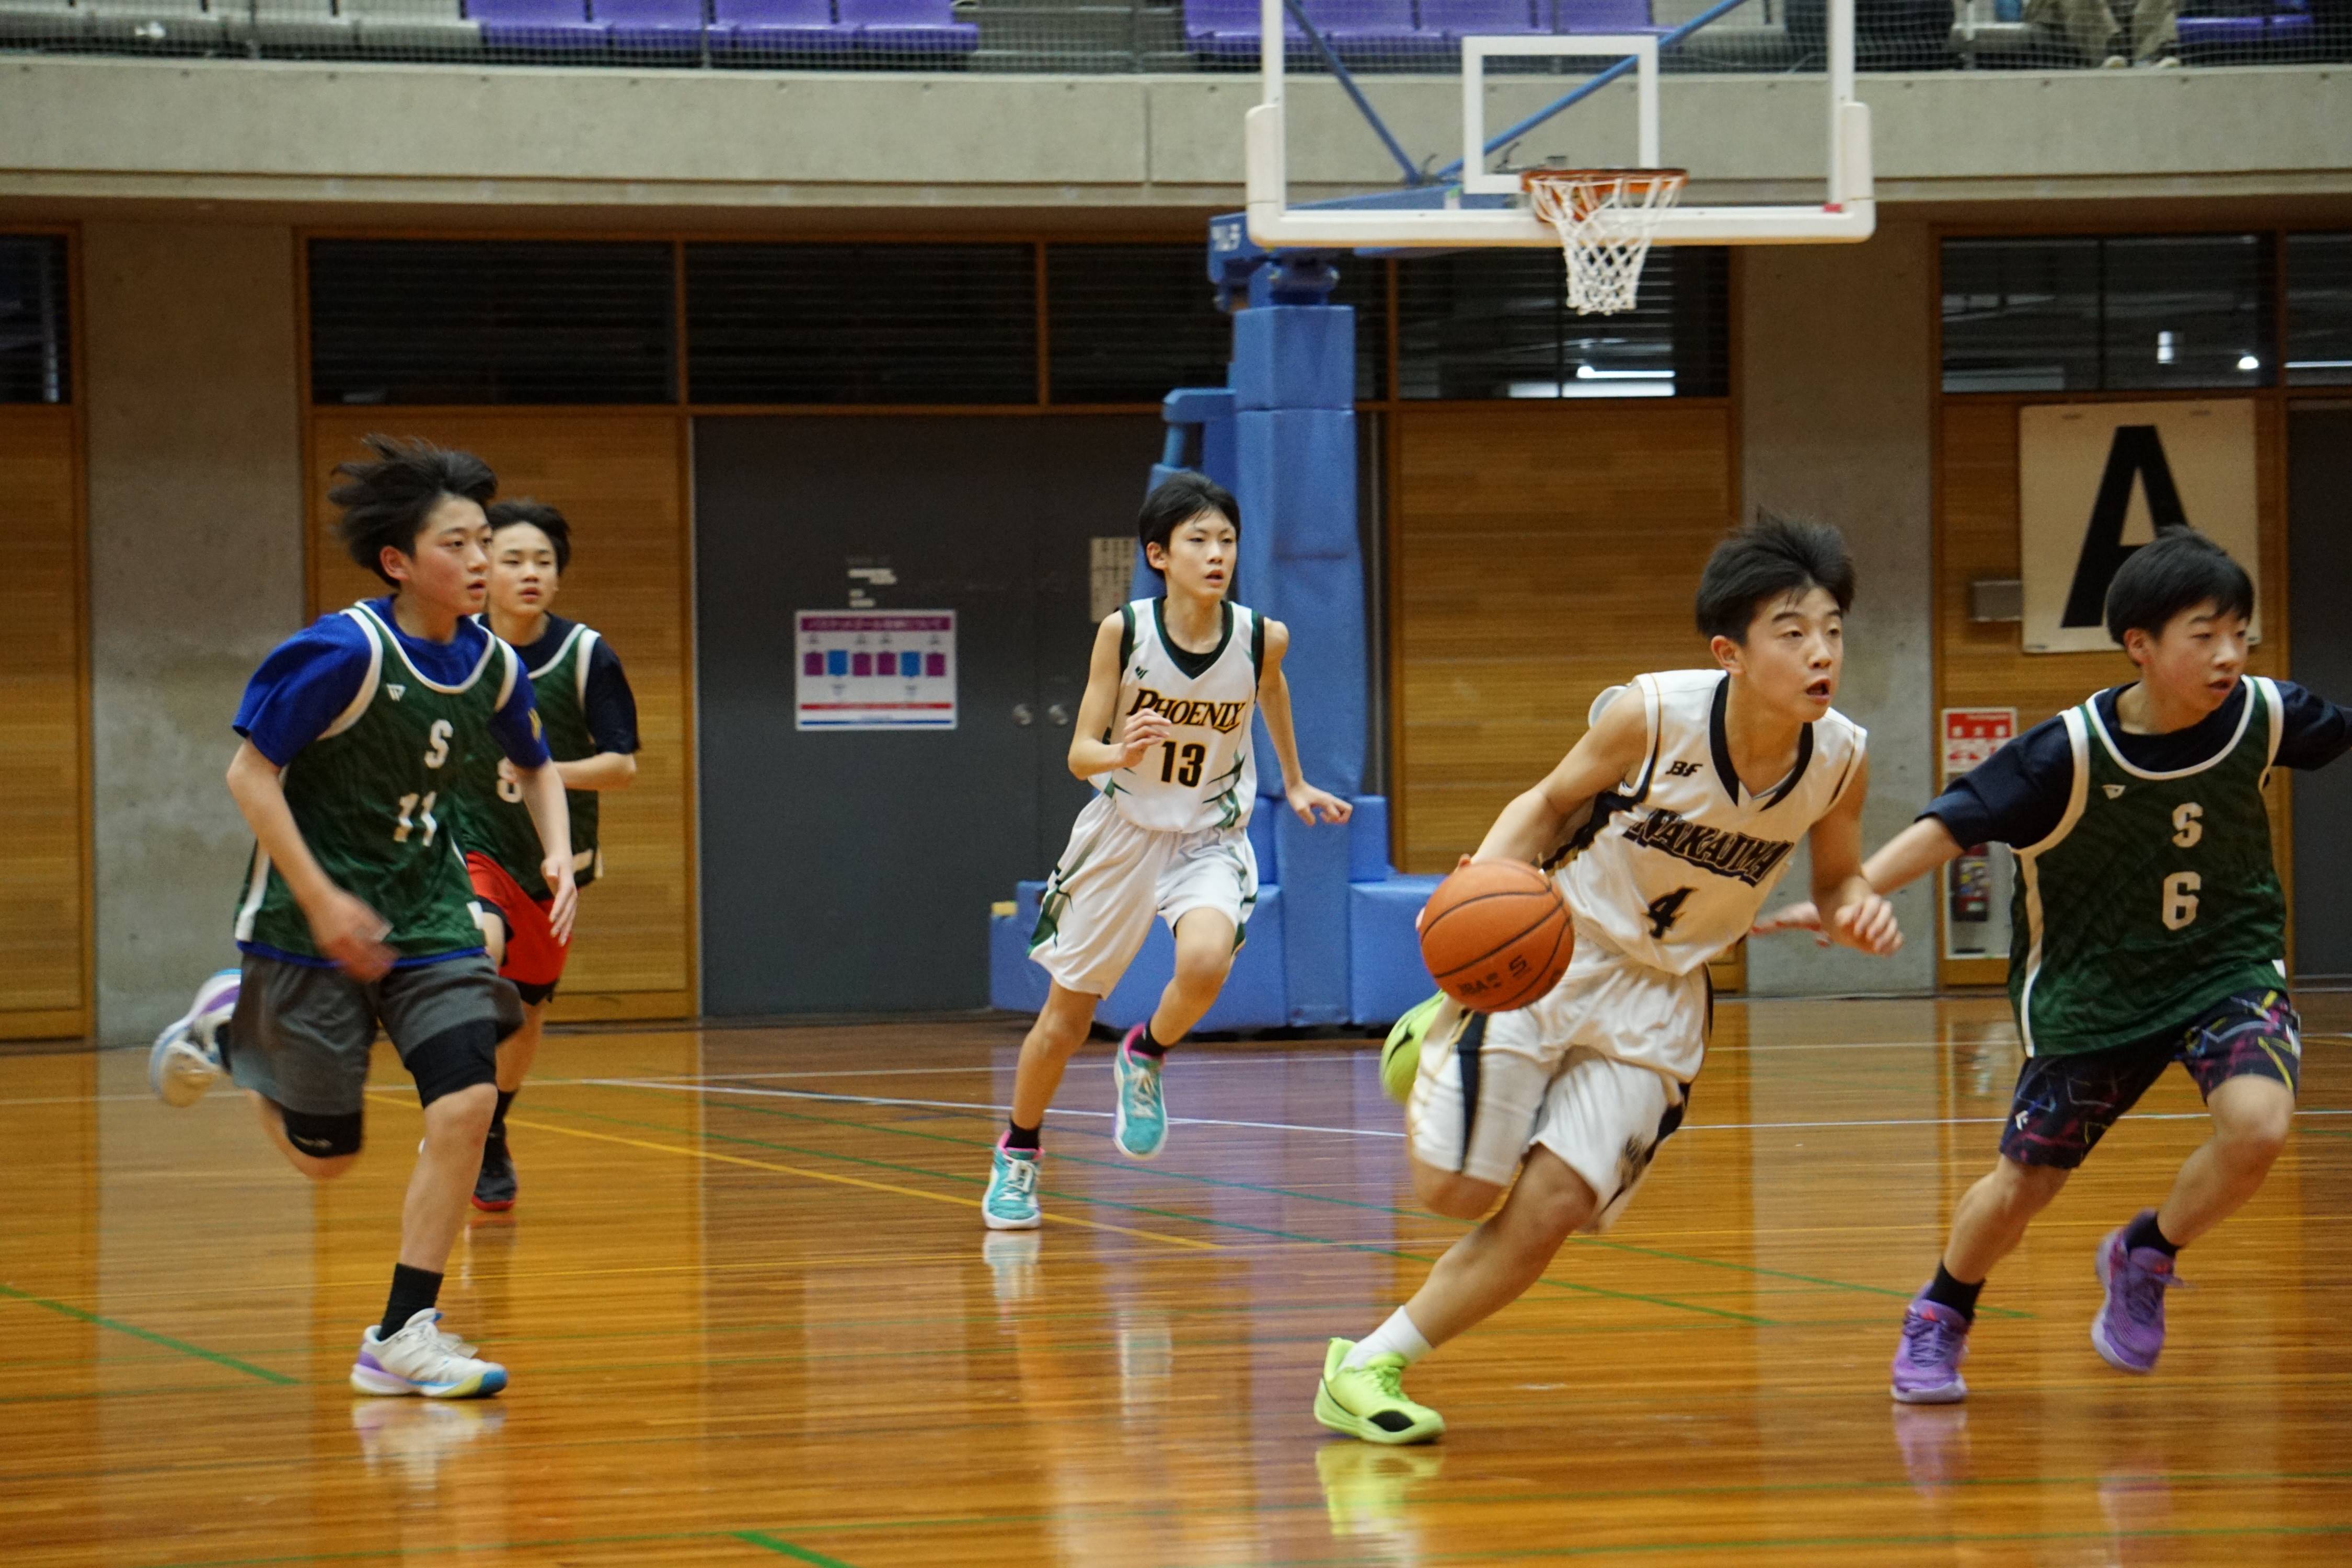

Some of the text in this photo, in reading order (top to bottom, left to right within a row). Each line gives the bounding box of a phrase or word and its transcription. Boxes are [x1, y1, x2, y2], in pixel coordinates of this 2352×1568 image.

[2060, 424, 2190, 628] A
[424, 719, 454, 769] S
[1160, 740, 1207, 788] 13
[1665, 760, 1704, 777] BF
[393, 791, 438, 847] 11
[2172, 801, 2204, 848] S
[1640, 885, 1700, 940] 4
[2162, 871, 2202, 931] 6
